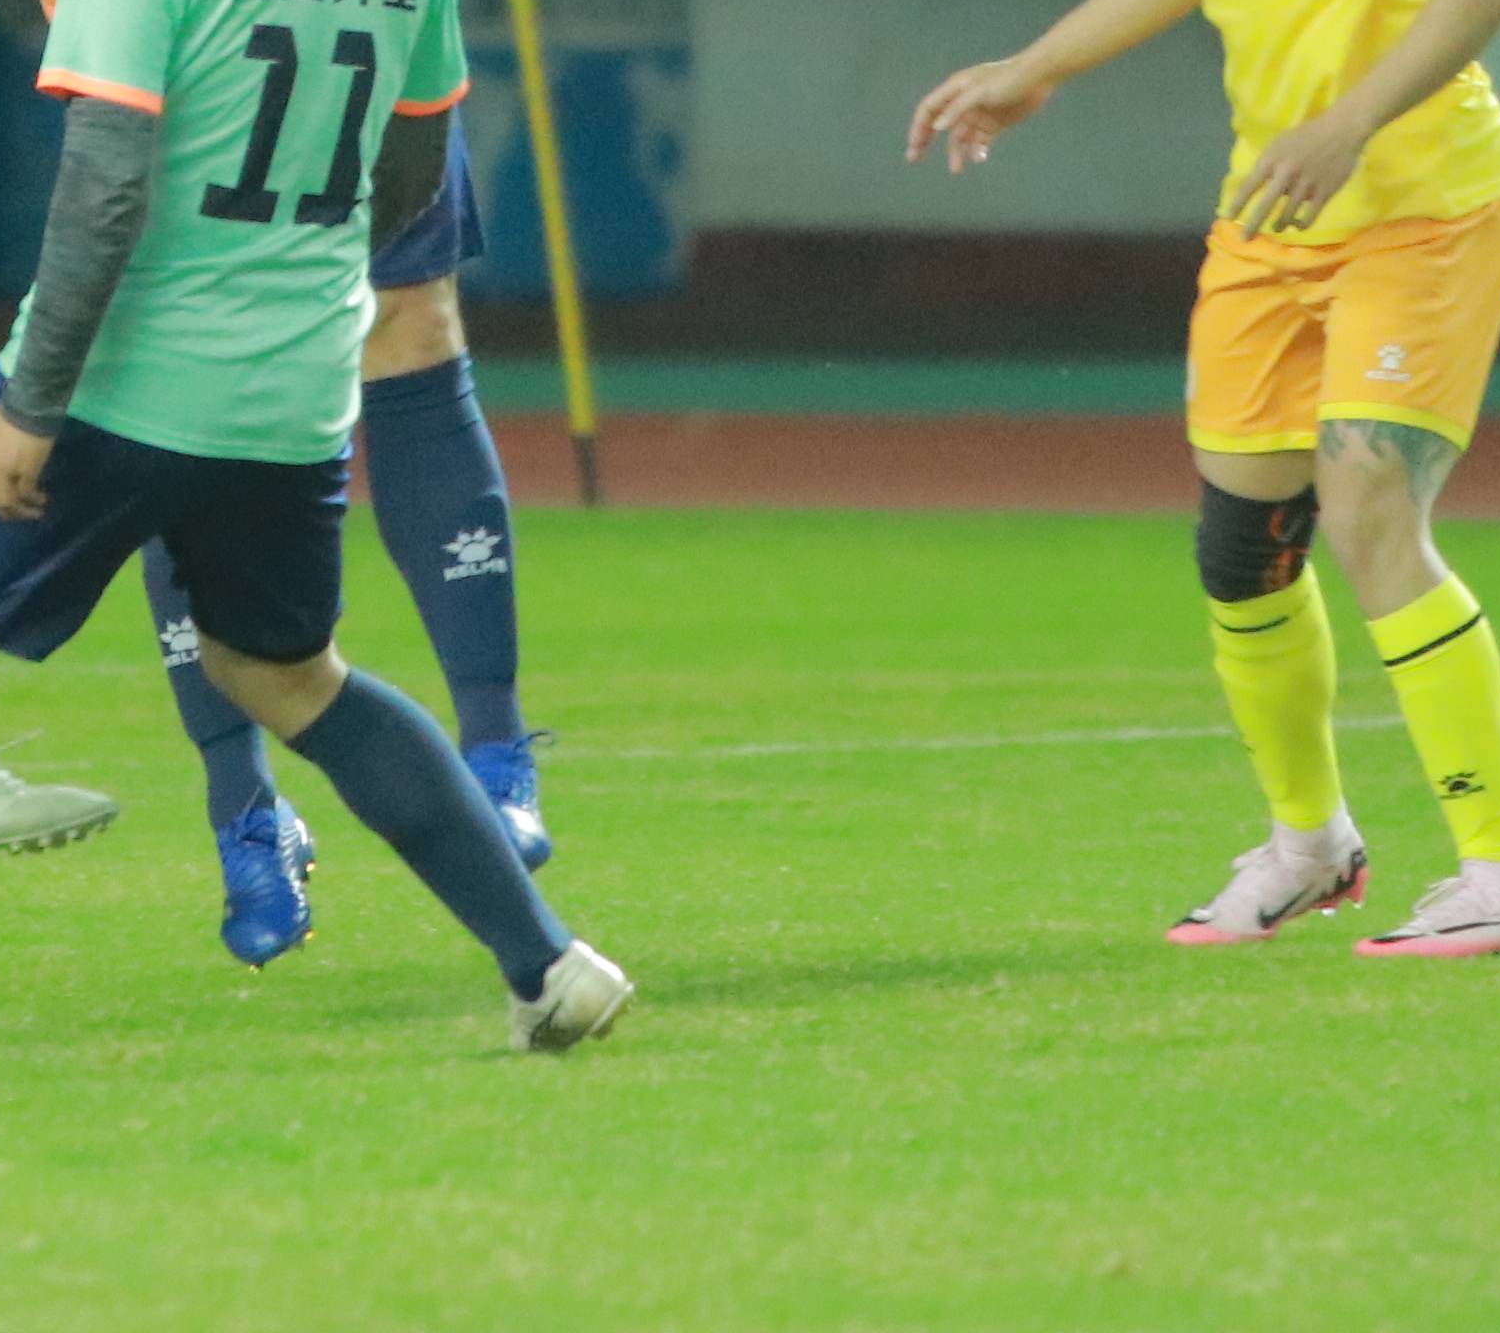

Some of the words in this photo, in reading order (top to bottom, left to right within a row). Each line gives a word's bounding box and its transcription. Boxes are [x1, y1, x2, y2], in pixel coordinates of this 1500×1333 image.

[200, 23, 376, 228] 11
[442, 557, 507, 582] KELME
[163, 649, 200, 669] KEL
